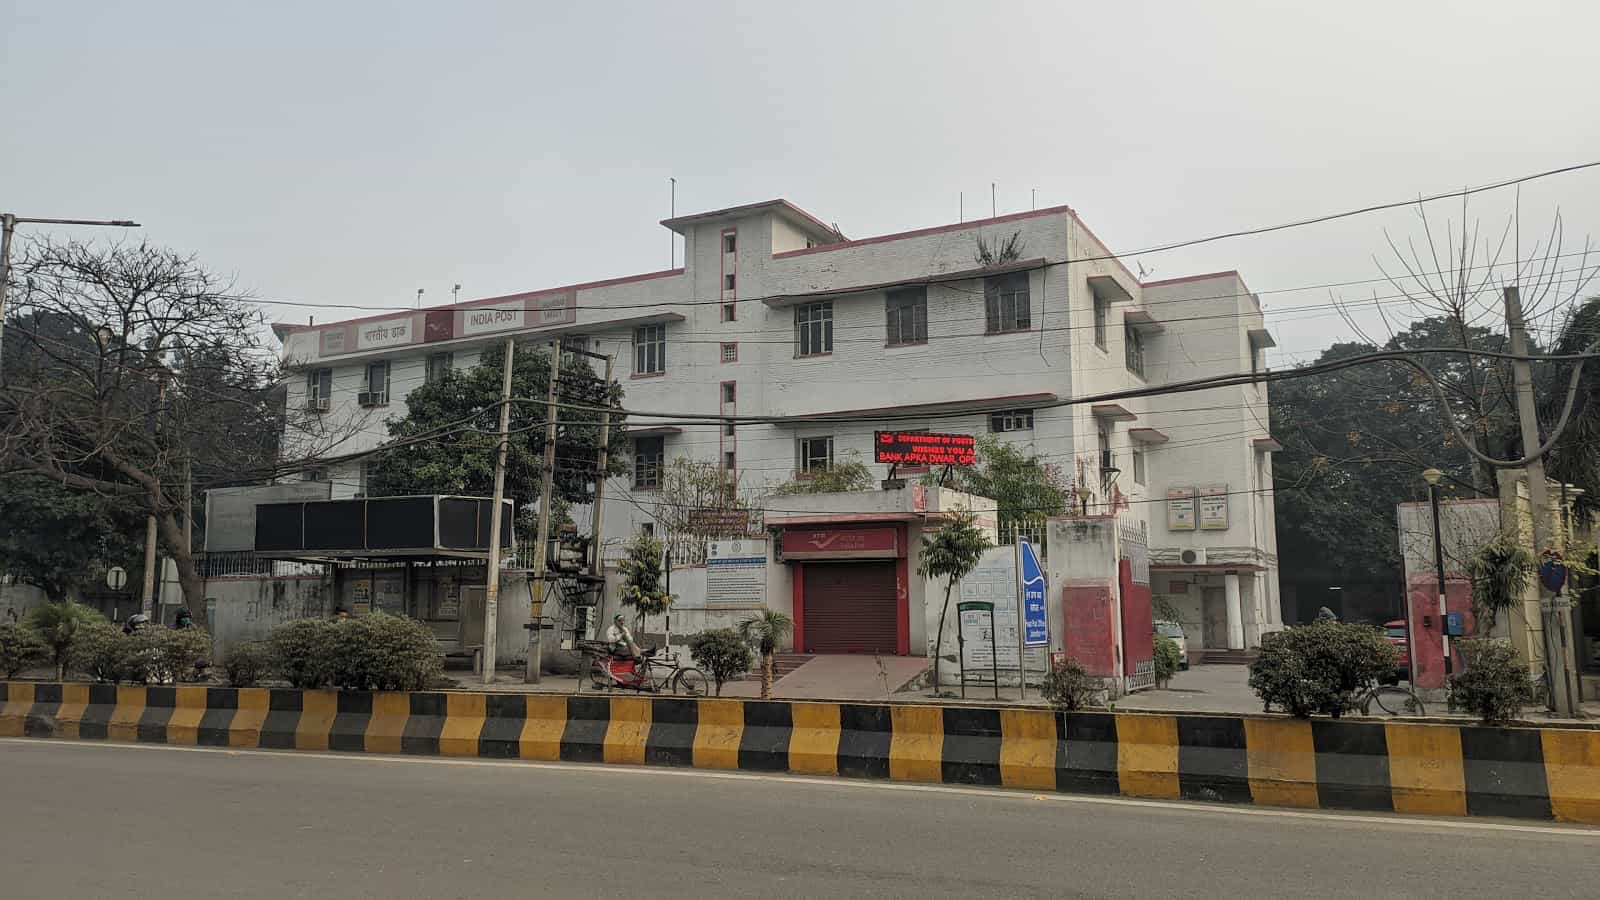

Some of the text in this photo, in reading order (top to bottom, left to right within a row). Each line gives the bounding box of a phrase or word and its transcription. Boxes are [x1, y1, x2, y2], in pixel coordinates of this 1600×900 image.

[470, 310, 517, 326] INDIA POST
[912, 446, 945, 454] WISHES
[947, 447, 965, 455] YOU
[880, 452, 902, 461] BANK
[904, 453, 928, 462] APKA
